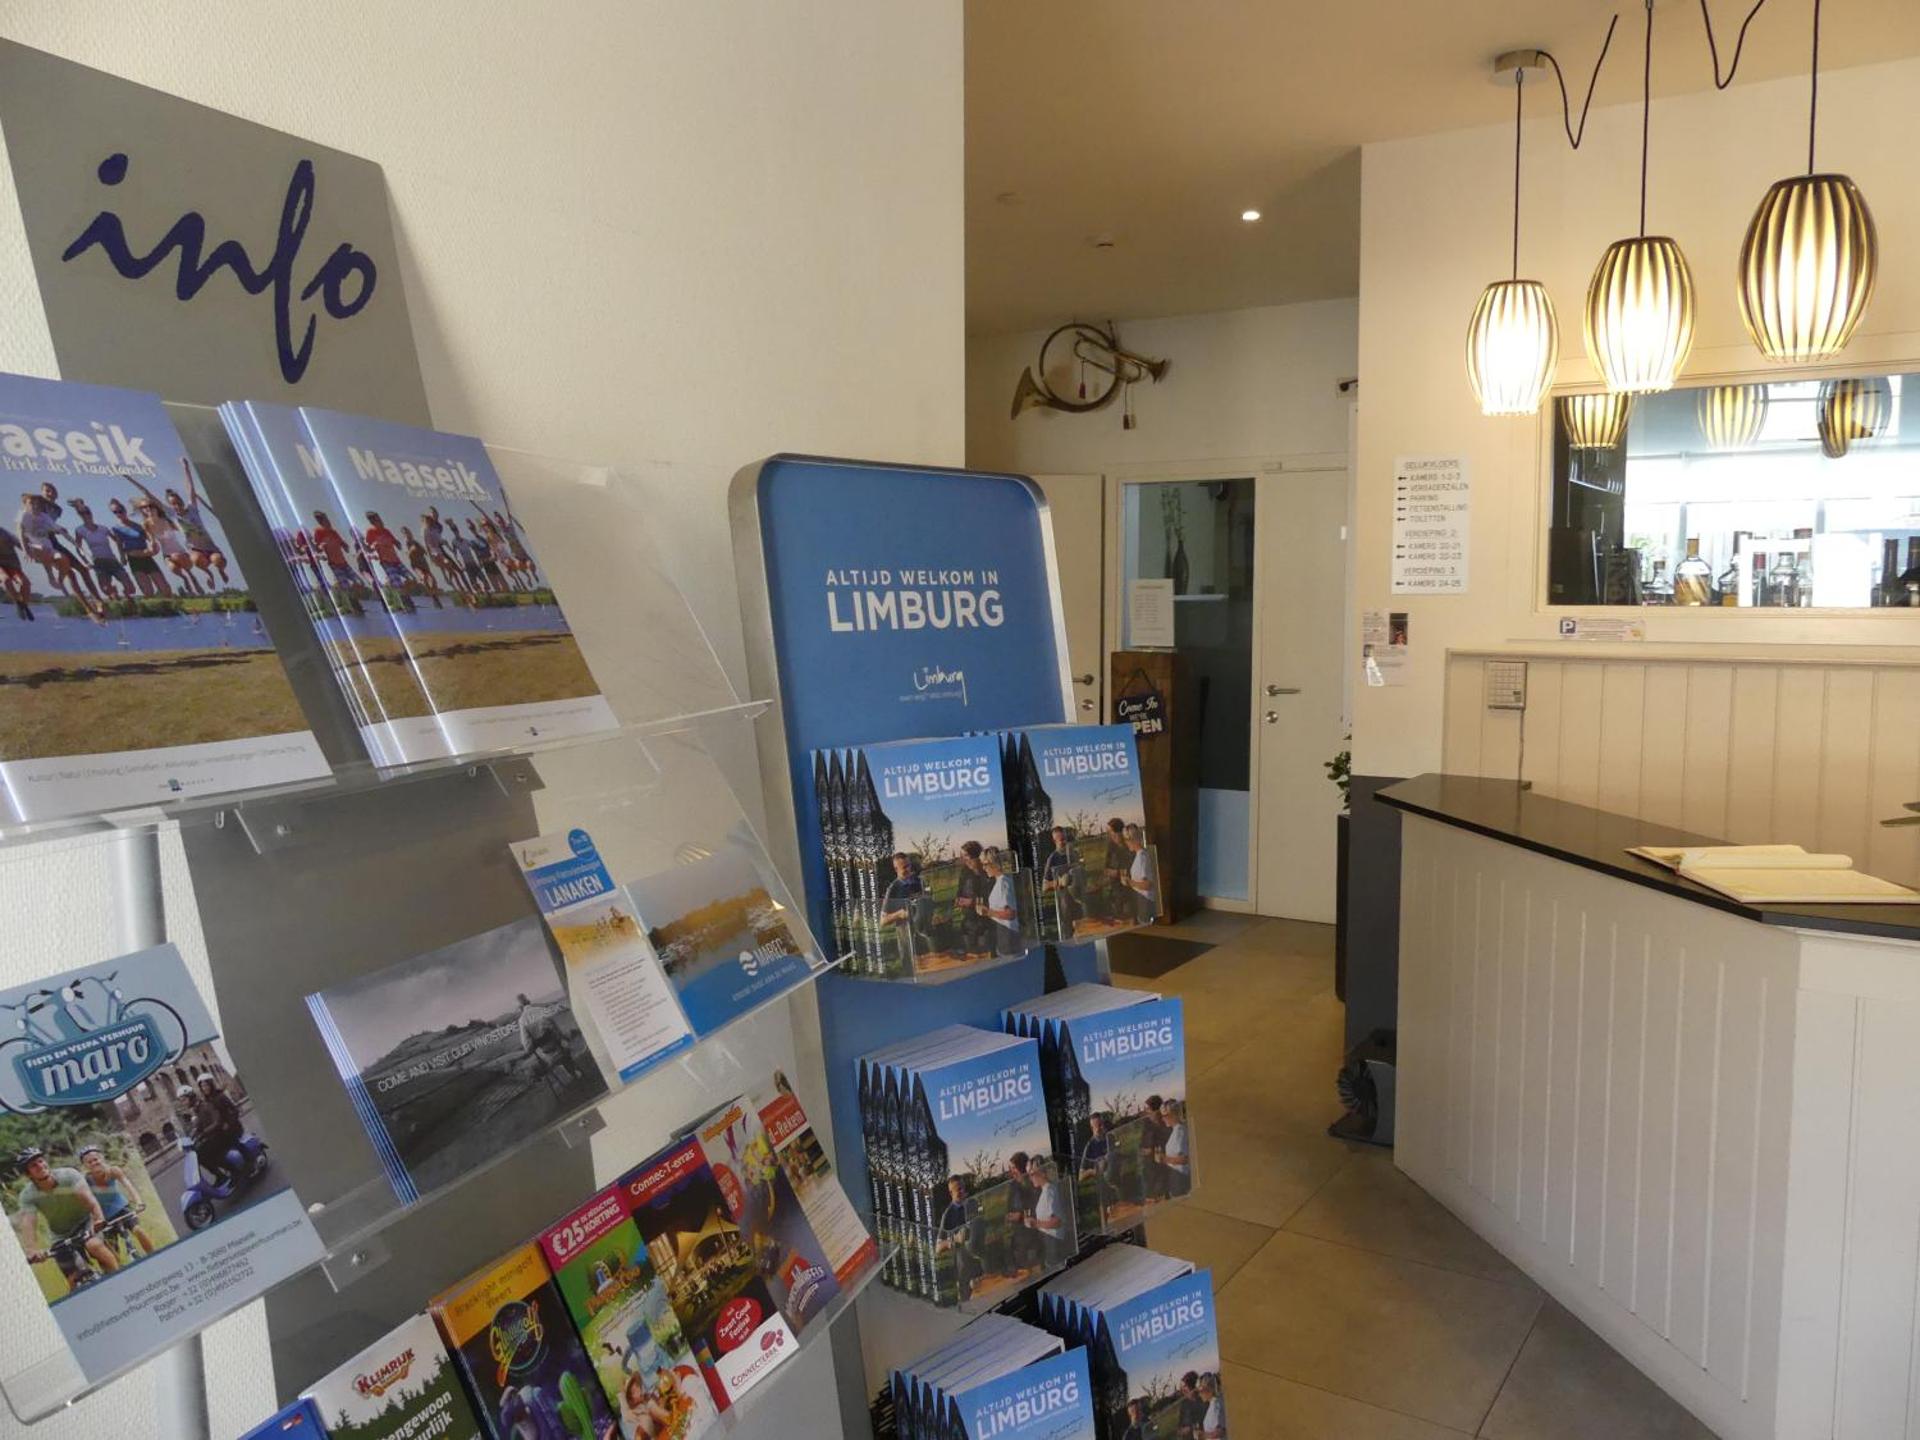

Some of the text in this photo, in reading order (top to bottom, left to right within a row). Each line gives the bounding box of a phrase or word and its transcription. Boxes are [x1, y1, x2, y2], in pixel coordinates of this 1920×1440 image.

[62, 153, 377, 383] info
[348, 446, 486, 495] Maaseik
[1407, 542, 1436, 550] KAMERS
[1407, 552, 1436, 560] KAMERS
[826, 570, 998, 586] ALTIJD WELKOM IN
[827, 589, 1005, 632] LIMBURG
[884, 756, 988, 776] ALTIJD WELKOM IN
[1043, 746, 1072, 756] ALTIJD
[1076, 743, 1113, 754] WELKOM
[1044, 751, 1129, 777] LIMBURG
[884, 766, 990, 798] LIMBURG
[545, 873, 604, 908] LANAKEN
[26, 1023, 145, 1068] FIETS EN VESPA VERHUUR
[1083, 1016, 1172, 1042] ALTIJD WELKOM IN
[1083, 1026, 1173, 1064] LIMBURG
[41, 1036, 149, 1097] maro
[98, 1078, 117, 1092] .BE
[378, 1072, 410, 1093] COME
[409, 1062, 430, 1079] AND
[430, 1052, 451, 1070] VISIT
[451, 1043, 471, 1060] OUR
[940, 1064, 1029, 1097] ALTIJD WELKOM IN
[940, 1074, 1032, 1120] LIMBURG
[552, 1220, 585, 1256] €25
[583, 1204, 620, 1235] KORTING
[1120, 1289, 1202, 1331] ALTIJD WELKOM IN
[1120, 1300, 1204, 1351] LIMBURG
[357, 1348, 415, 1394] KLIMRIJK
[976, 1396, 1012, 1418] ALTIJD
[1016, 1376, 1061, 1400] WELKOM
[1065, 1371, 1077, 1380] IN
[977, 1382, 1079, 1440] LIMBURG
